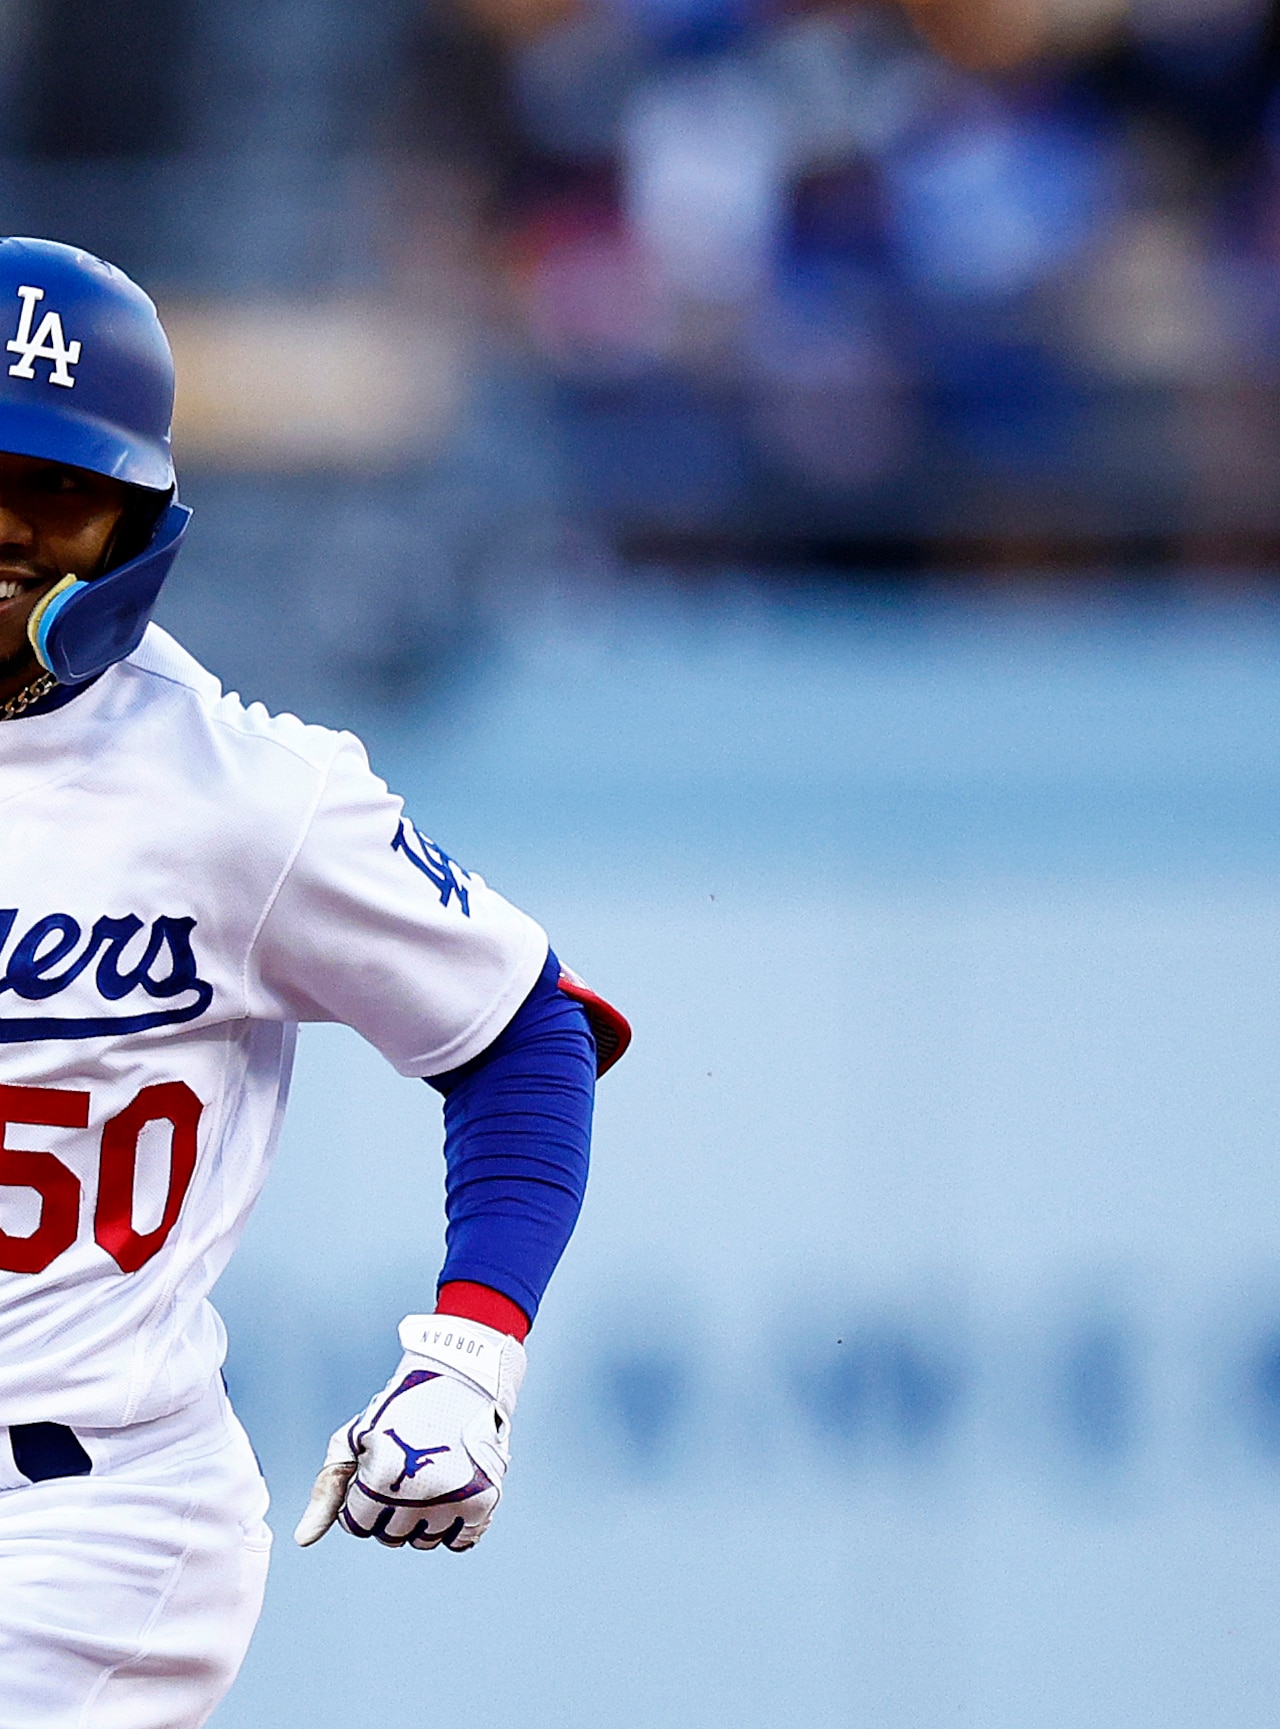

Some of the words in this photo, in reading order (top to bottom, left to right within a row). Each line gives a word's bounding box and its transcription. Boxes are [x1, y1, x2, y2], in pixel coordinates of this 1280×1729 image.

[6, 285, 81, 388] LA
[390, 818, 471, 918] LA
[422, 1331, 484, 1357] JORDAN
